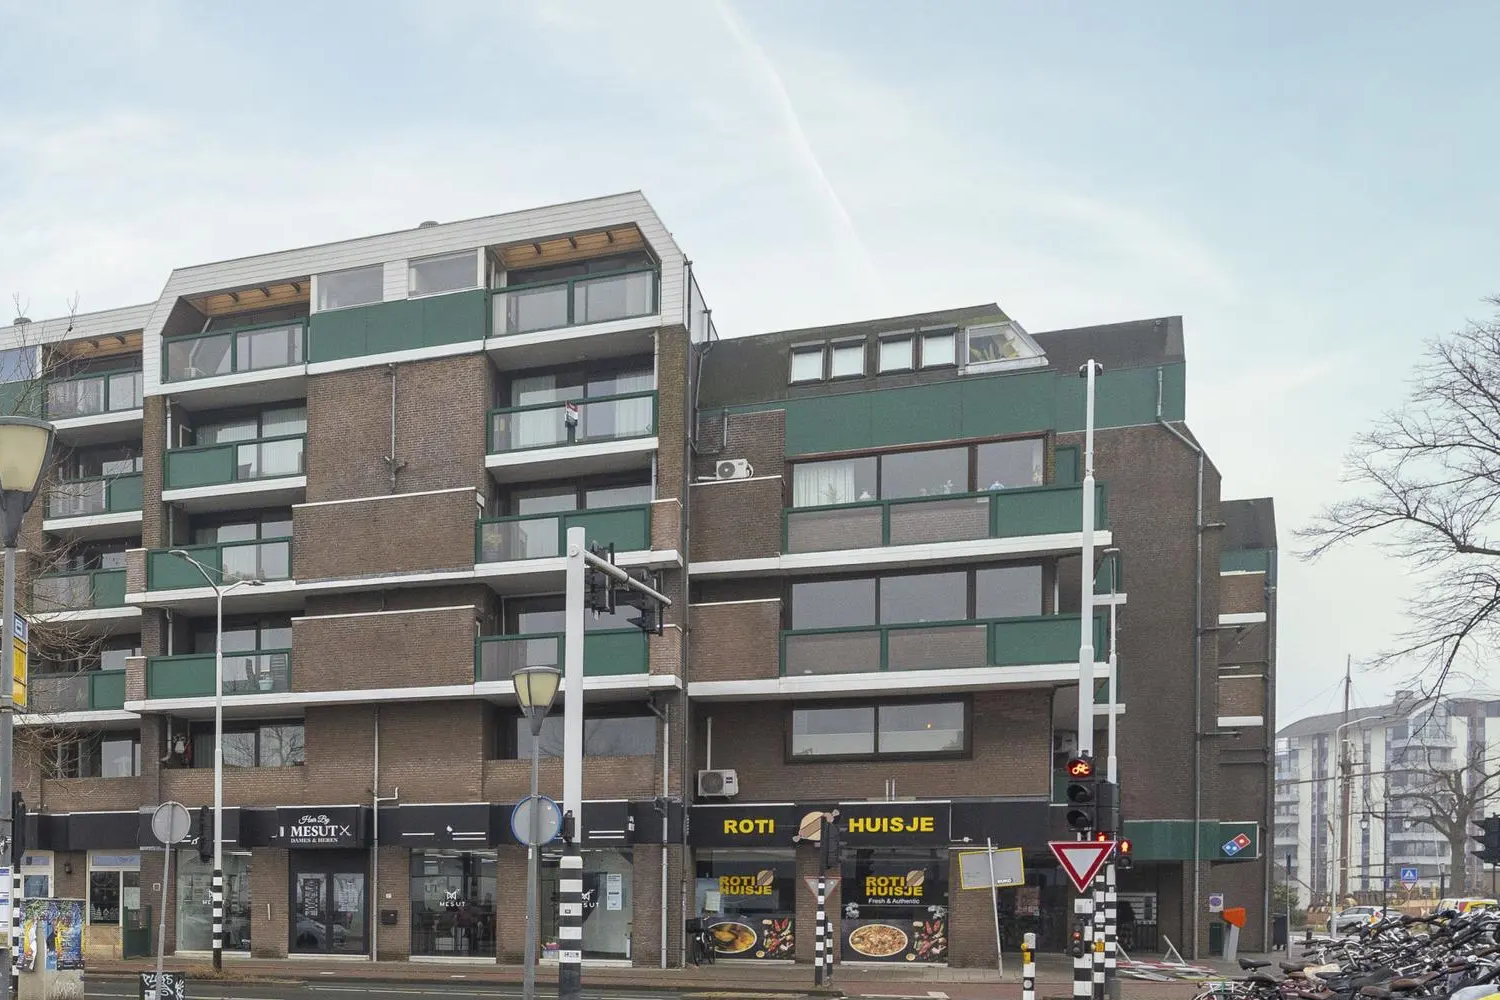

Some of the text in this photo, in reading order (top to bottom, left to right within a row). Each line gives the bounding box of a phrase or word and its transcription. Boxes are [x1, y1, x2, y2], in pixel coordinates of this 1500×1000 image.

[723, 816, 934, 834] ROTI HUISJE
[290, 825, 338, 837] MESUT
[719, 875, 756, 886] ROTI
[865, 876, 905, 887] ROTI
[719, 885, 773, 895] HUISJE
[865, 886, 923, 896] HUISJE
